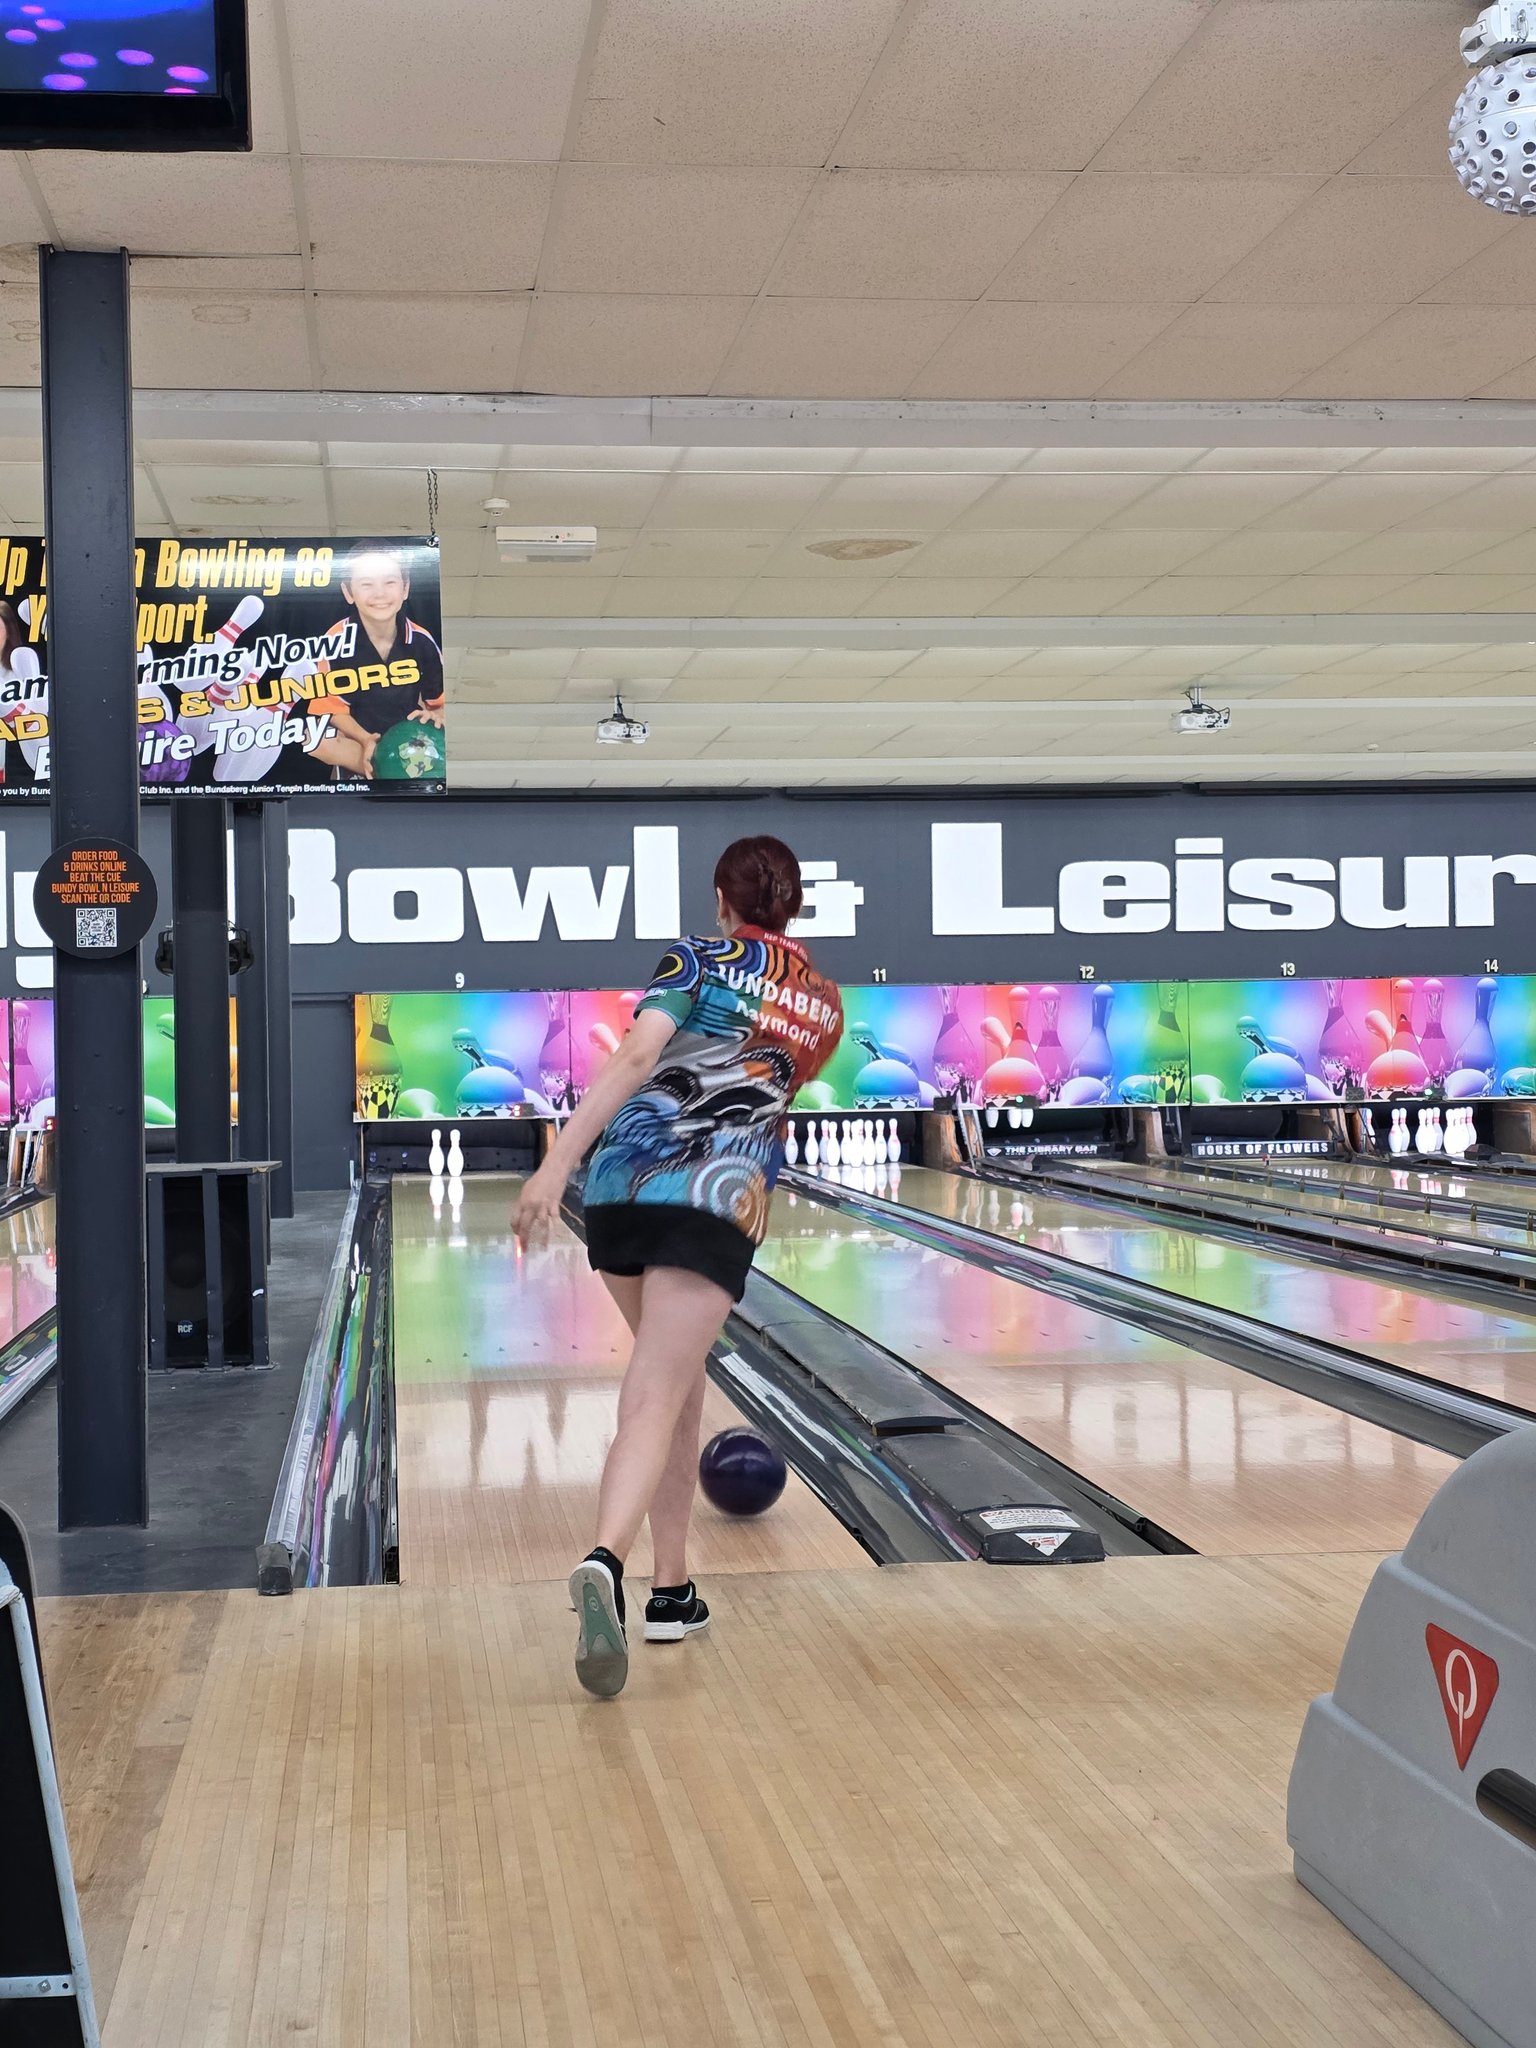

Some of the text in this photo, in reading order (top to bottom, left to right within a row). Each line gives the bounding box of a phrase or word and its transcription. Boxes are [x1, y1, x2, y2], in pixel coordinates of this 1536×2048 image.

[155, 539, 285, 597] Bowling
[294, 547, 334, 588] as
[135, 595, 216, 652] port.
[137, 647, 244, 685] rming
[254, 624, 356, 669] Now!
[179, 691, 213, 717] &
[223, 658, 421, 711] JUNIORS
[208, 711, 337, 754] Today.
[3, 787, 18, 795] you
[19, 786, 30, 795] by
[139, 786, 158, 794] Club
[158, 786, 173, 794] Inc.
[174, 785, 190, 794] and
[191, 785, 204, 794] the
[205, 785, 248, 795] Bundaberg
[249, 785, 275, 793] Junior
[303, 784, 336, 793] Bowling
[336, 783, 356, 792] Club
[356, 783, 371, 792] Inc.
[72, 851, 118, 860] ORDER FOOD
[63, 862, 127, 871] & DRINKS ONLINE
[70, 872, 121, 882] BEAT THE CUE
[52, 883, 140, 893] BUNDY BOWL N LEISURE
[61, 893, 131, 903] SCAN THE QR CODE
[1079, 966, 1094, 980] 12
[1280, 962, 1295, 976] 13
[1484, 959, 1499, 974] 14
[455, 972, 465, 988] 9
[872, 969, 887, 982] 11
[1075, 1145, 1098, 1153] BAR
[1198, 1142, 1329, 1155] HOUSE OF FLOWERS
[178, 1324, 193, 1333] RCF
